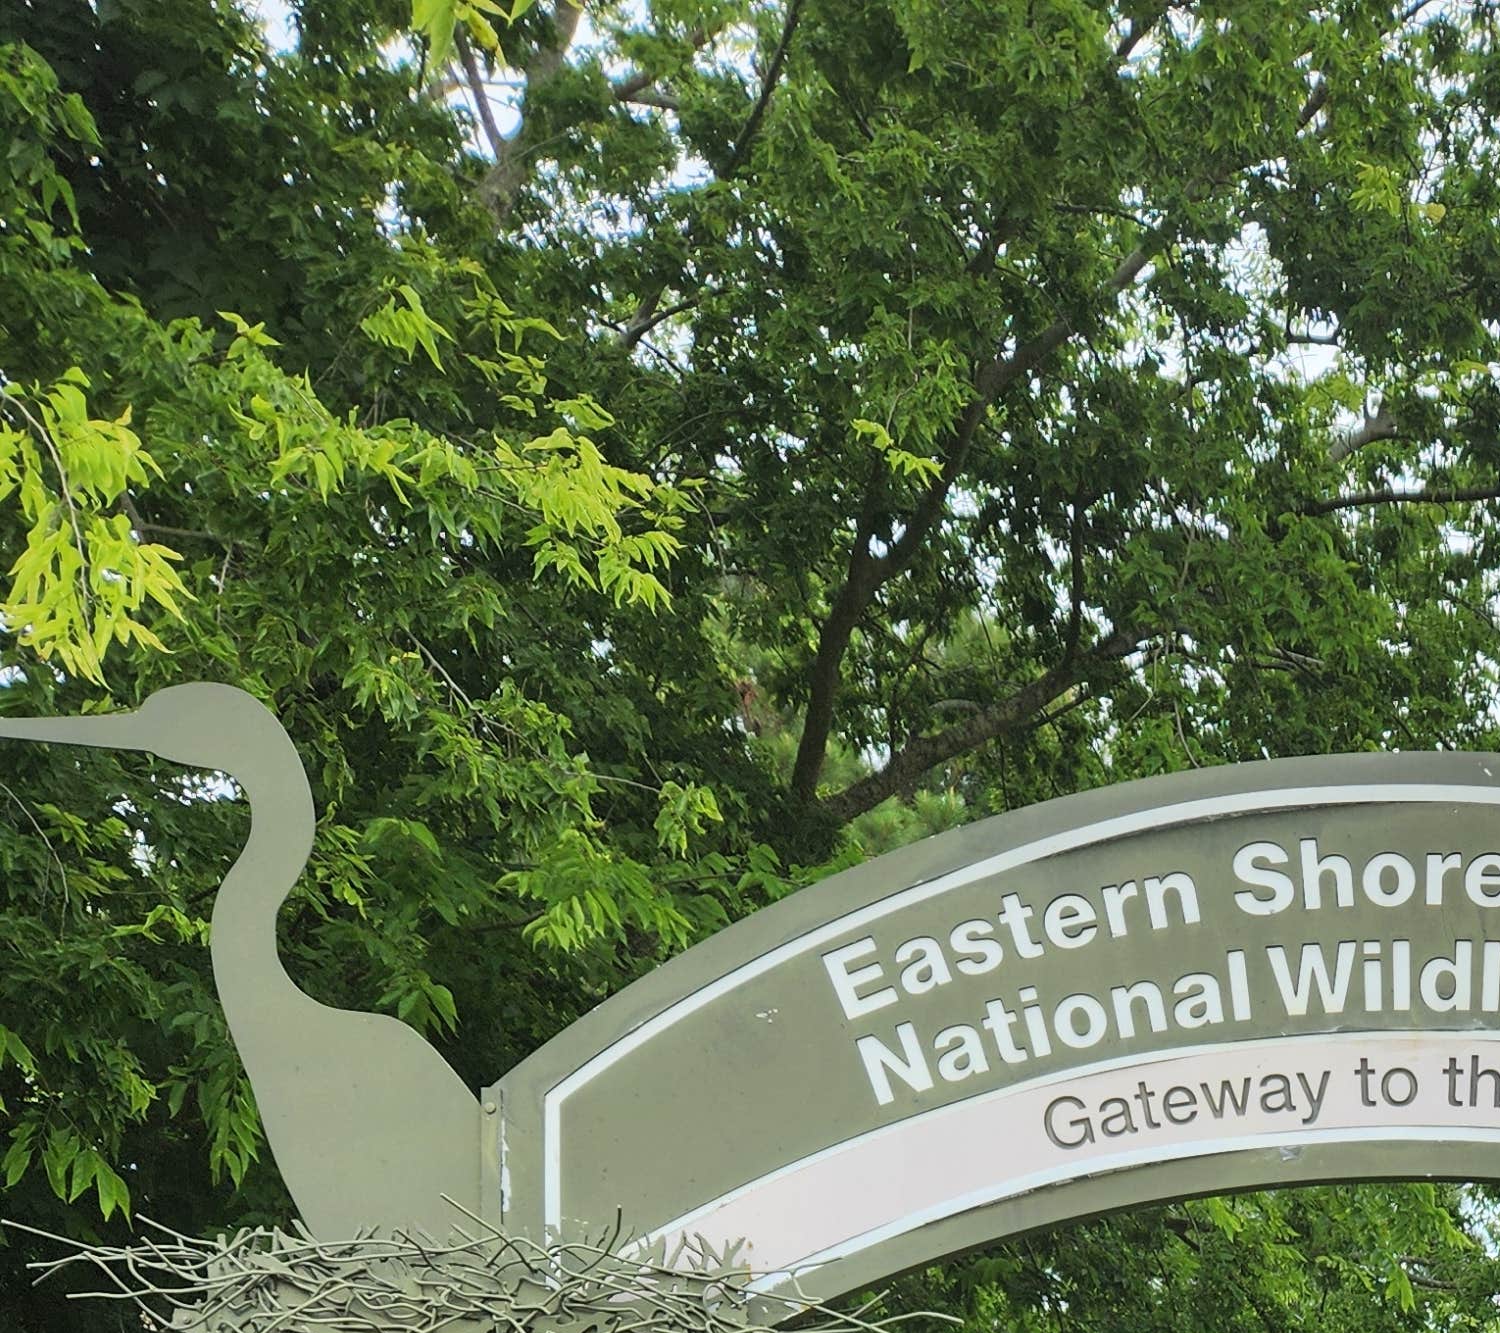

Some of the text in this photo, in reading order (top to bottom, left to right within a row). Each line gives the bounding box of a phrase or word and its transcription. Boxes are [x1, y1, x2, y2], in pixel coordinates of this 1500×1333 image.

[822, 872, 1201, 1020] Eastern
[854, 949, 1252, 1106] National
[1043, 1069, 1331, 1151] Gateway
[1354, 1057, 1419, 1107] to
